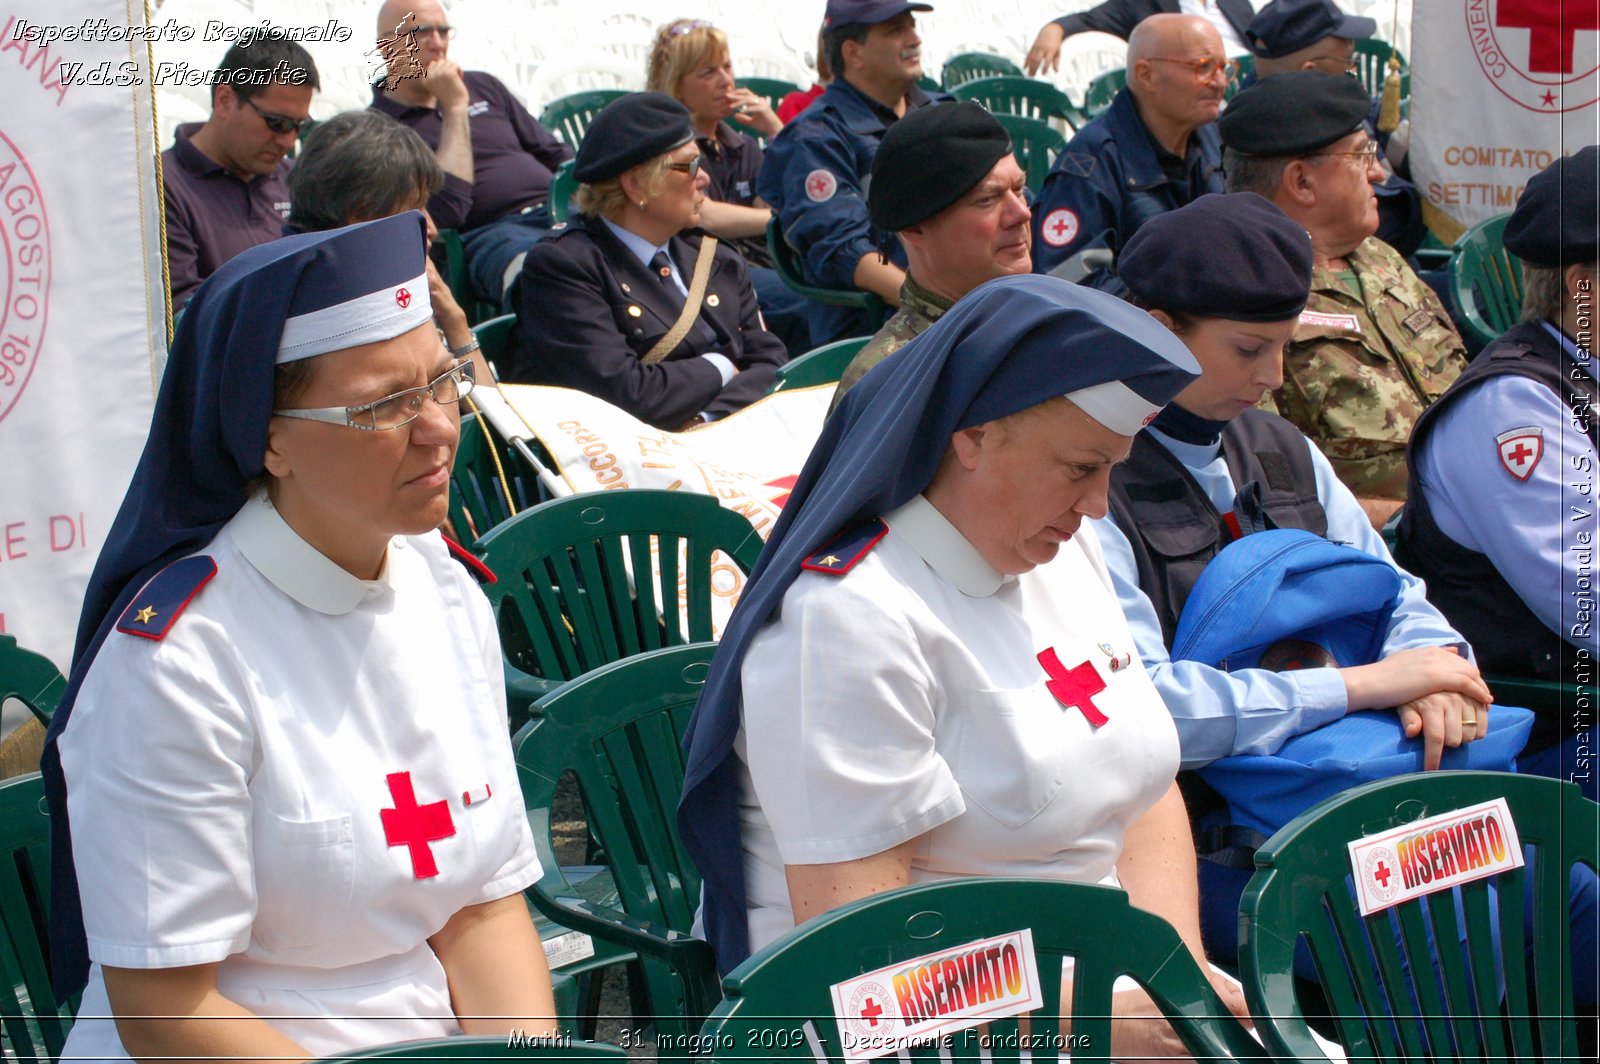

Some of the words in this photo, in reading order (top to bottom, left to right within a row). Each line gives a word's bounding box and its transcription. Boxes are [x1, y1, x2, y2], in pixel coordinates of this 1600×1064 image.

[1444, 146, 1553, 170] COMITATO
[50, 512, 86, 552] DI
[1397, 814, 1507, 889] RISERVATO
[892, 943, 1022, 1027] RISERVATO
